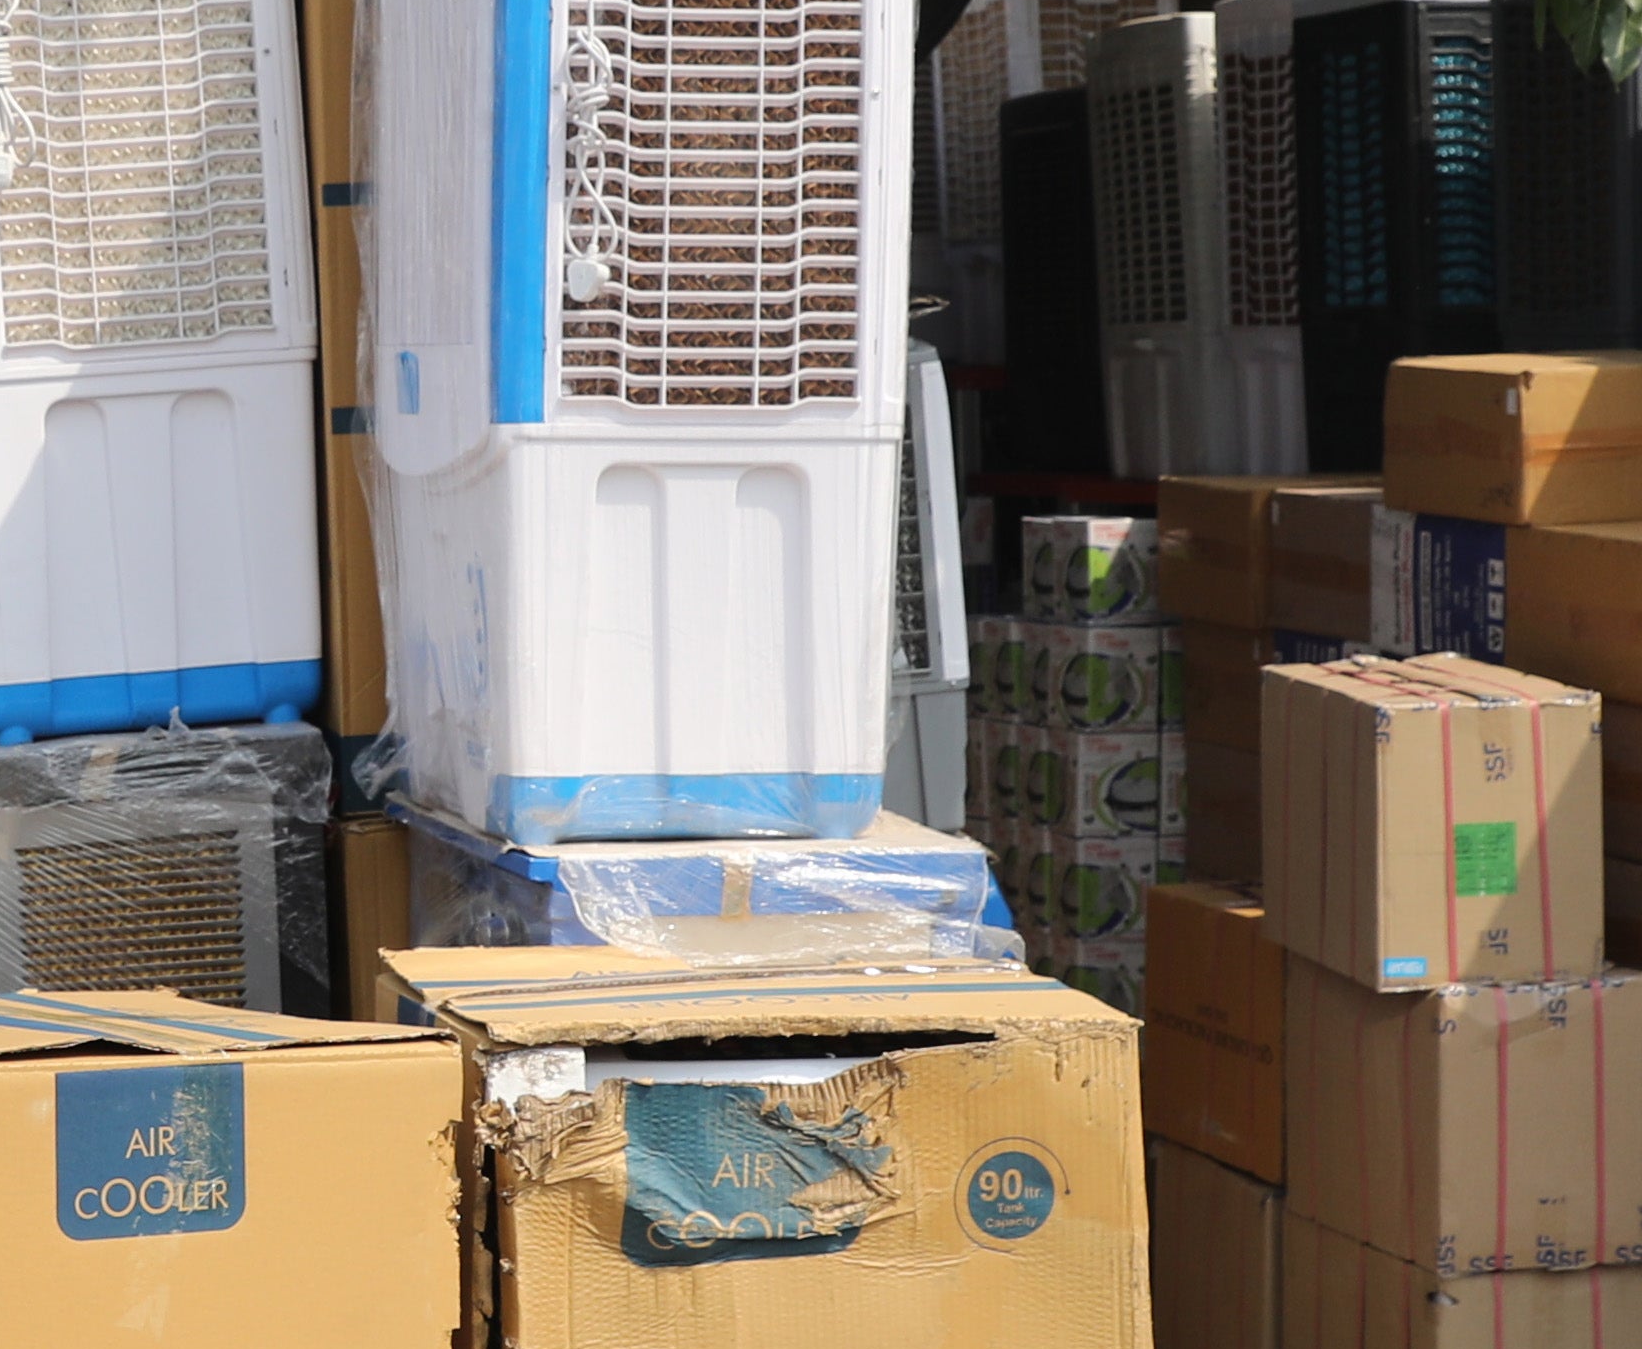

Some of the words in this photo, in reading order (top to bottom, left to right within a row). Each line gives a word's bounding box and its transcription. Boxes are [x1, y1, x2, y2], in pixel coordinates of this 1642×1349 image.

[126, 1126, 176, 1159] AIR
[712, 1152, 777, 1189] AIR
[979, 1168, 1022, 1202] 90
[75, 1174, 229, 1220] COOLER
[997, 1202, 1026, 1214] Tank
[984, 1217, 1039, 1231] Capacity
